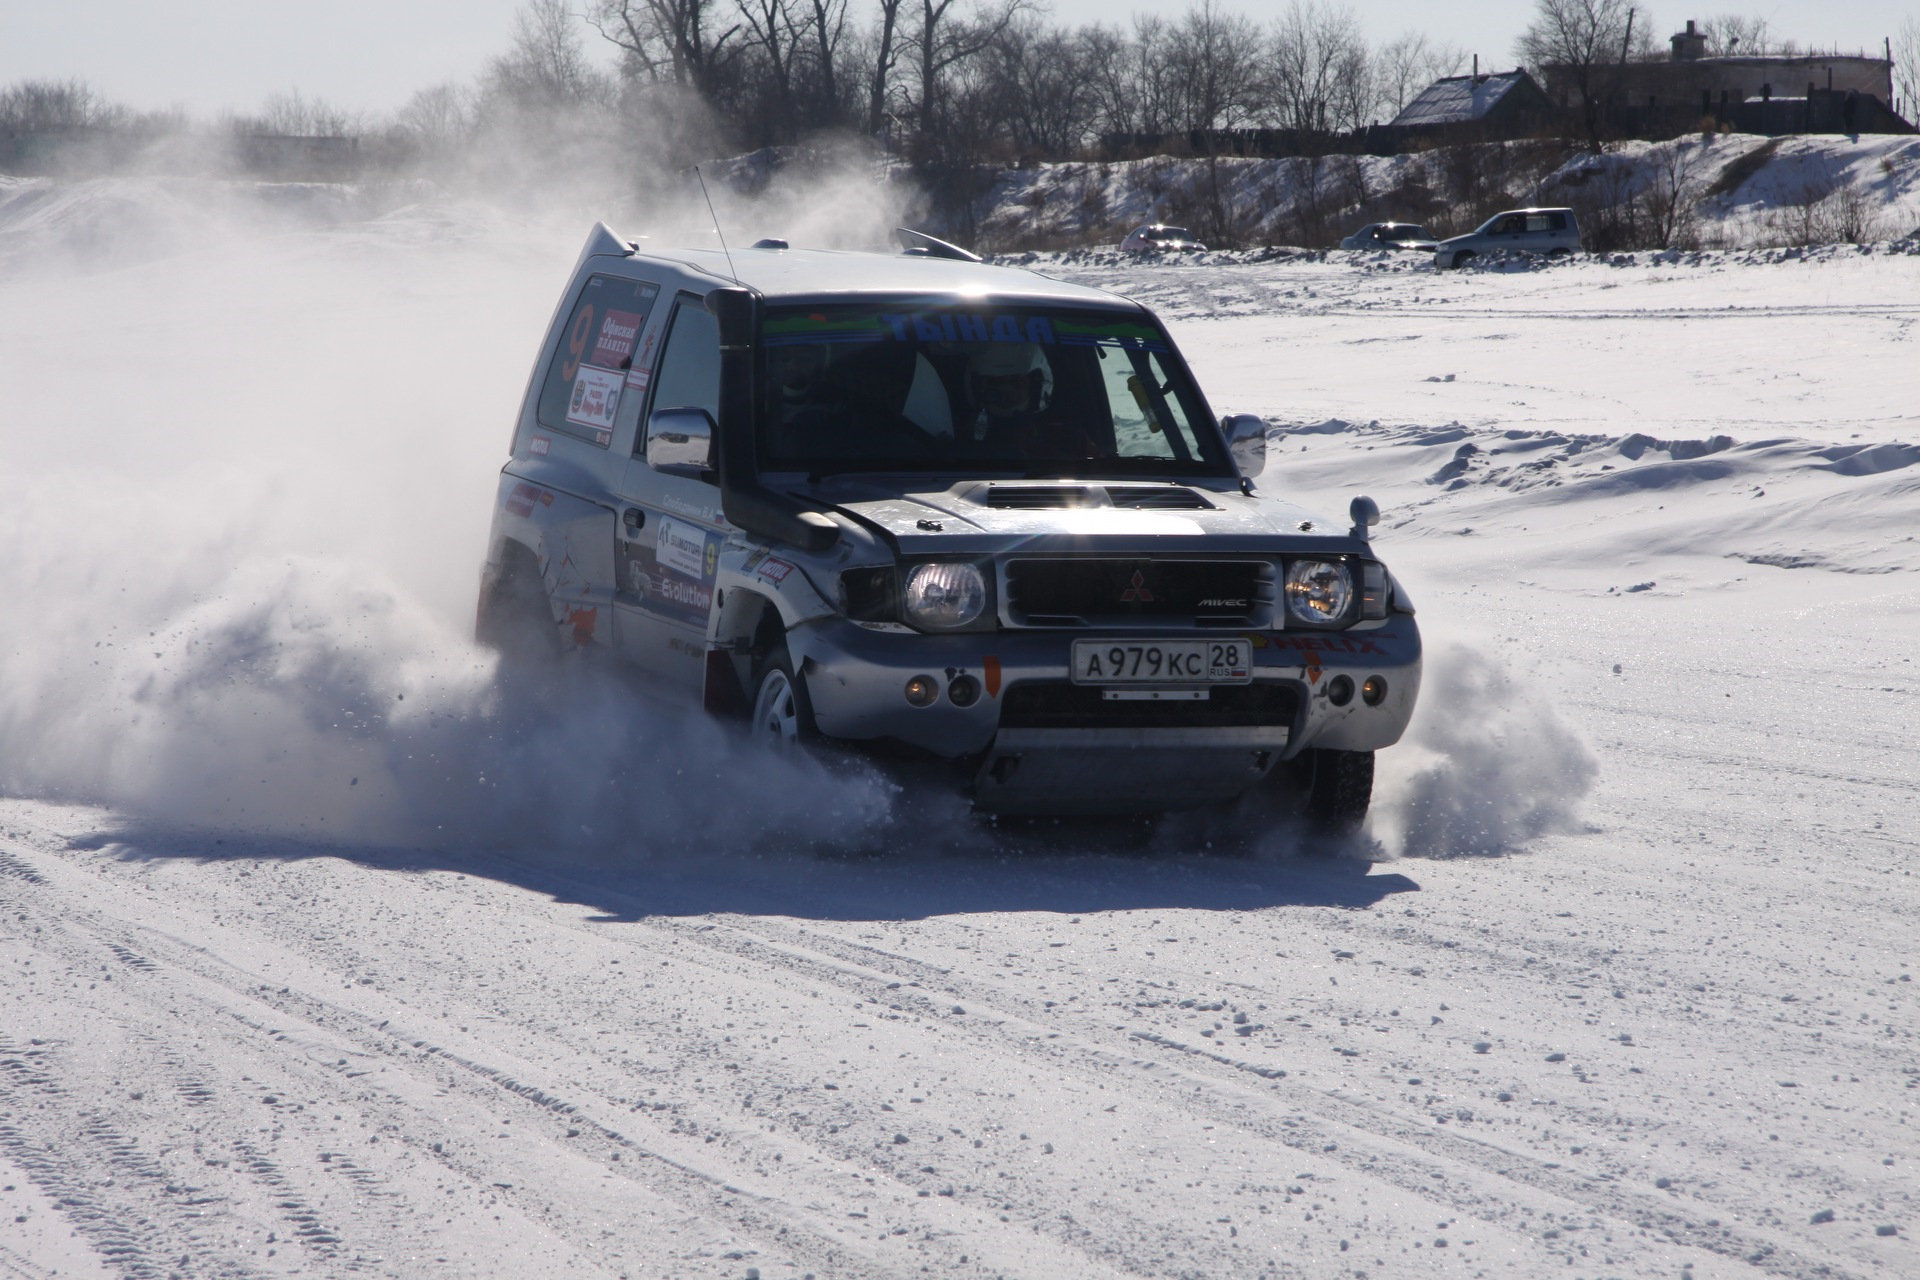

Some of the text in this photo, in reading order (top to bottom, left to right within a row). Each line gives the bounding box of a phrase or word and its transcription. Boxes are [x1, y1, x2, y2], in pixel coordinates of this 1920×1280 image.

[602, 317, 636, 340] Офисная
[882, 314, 1055, 343] ТЫНДА
[563, 304, 594, 381] 9
[706, 543, 715, 576] 9
[760, 560, 790, 581] MOTUL
[662, 578, 710, 609] Evolution
[1211, 645, 1239, 668] 28
[1270, 634, 1391, 656] HELIX
[1210, 668, 1230, 677] RUS
